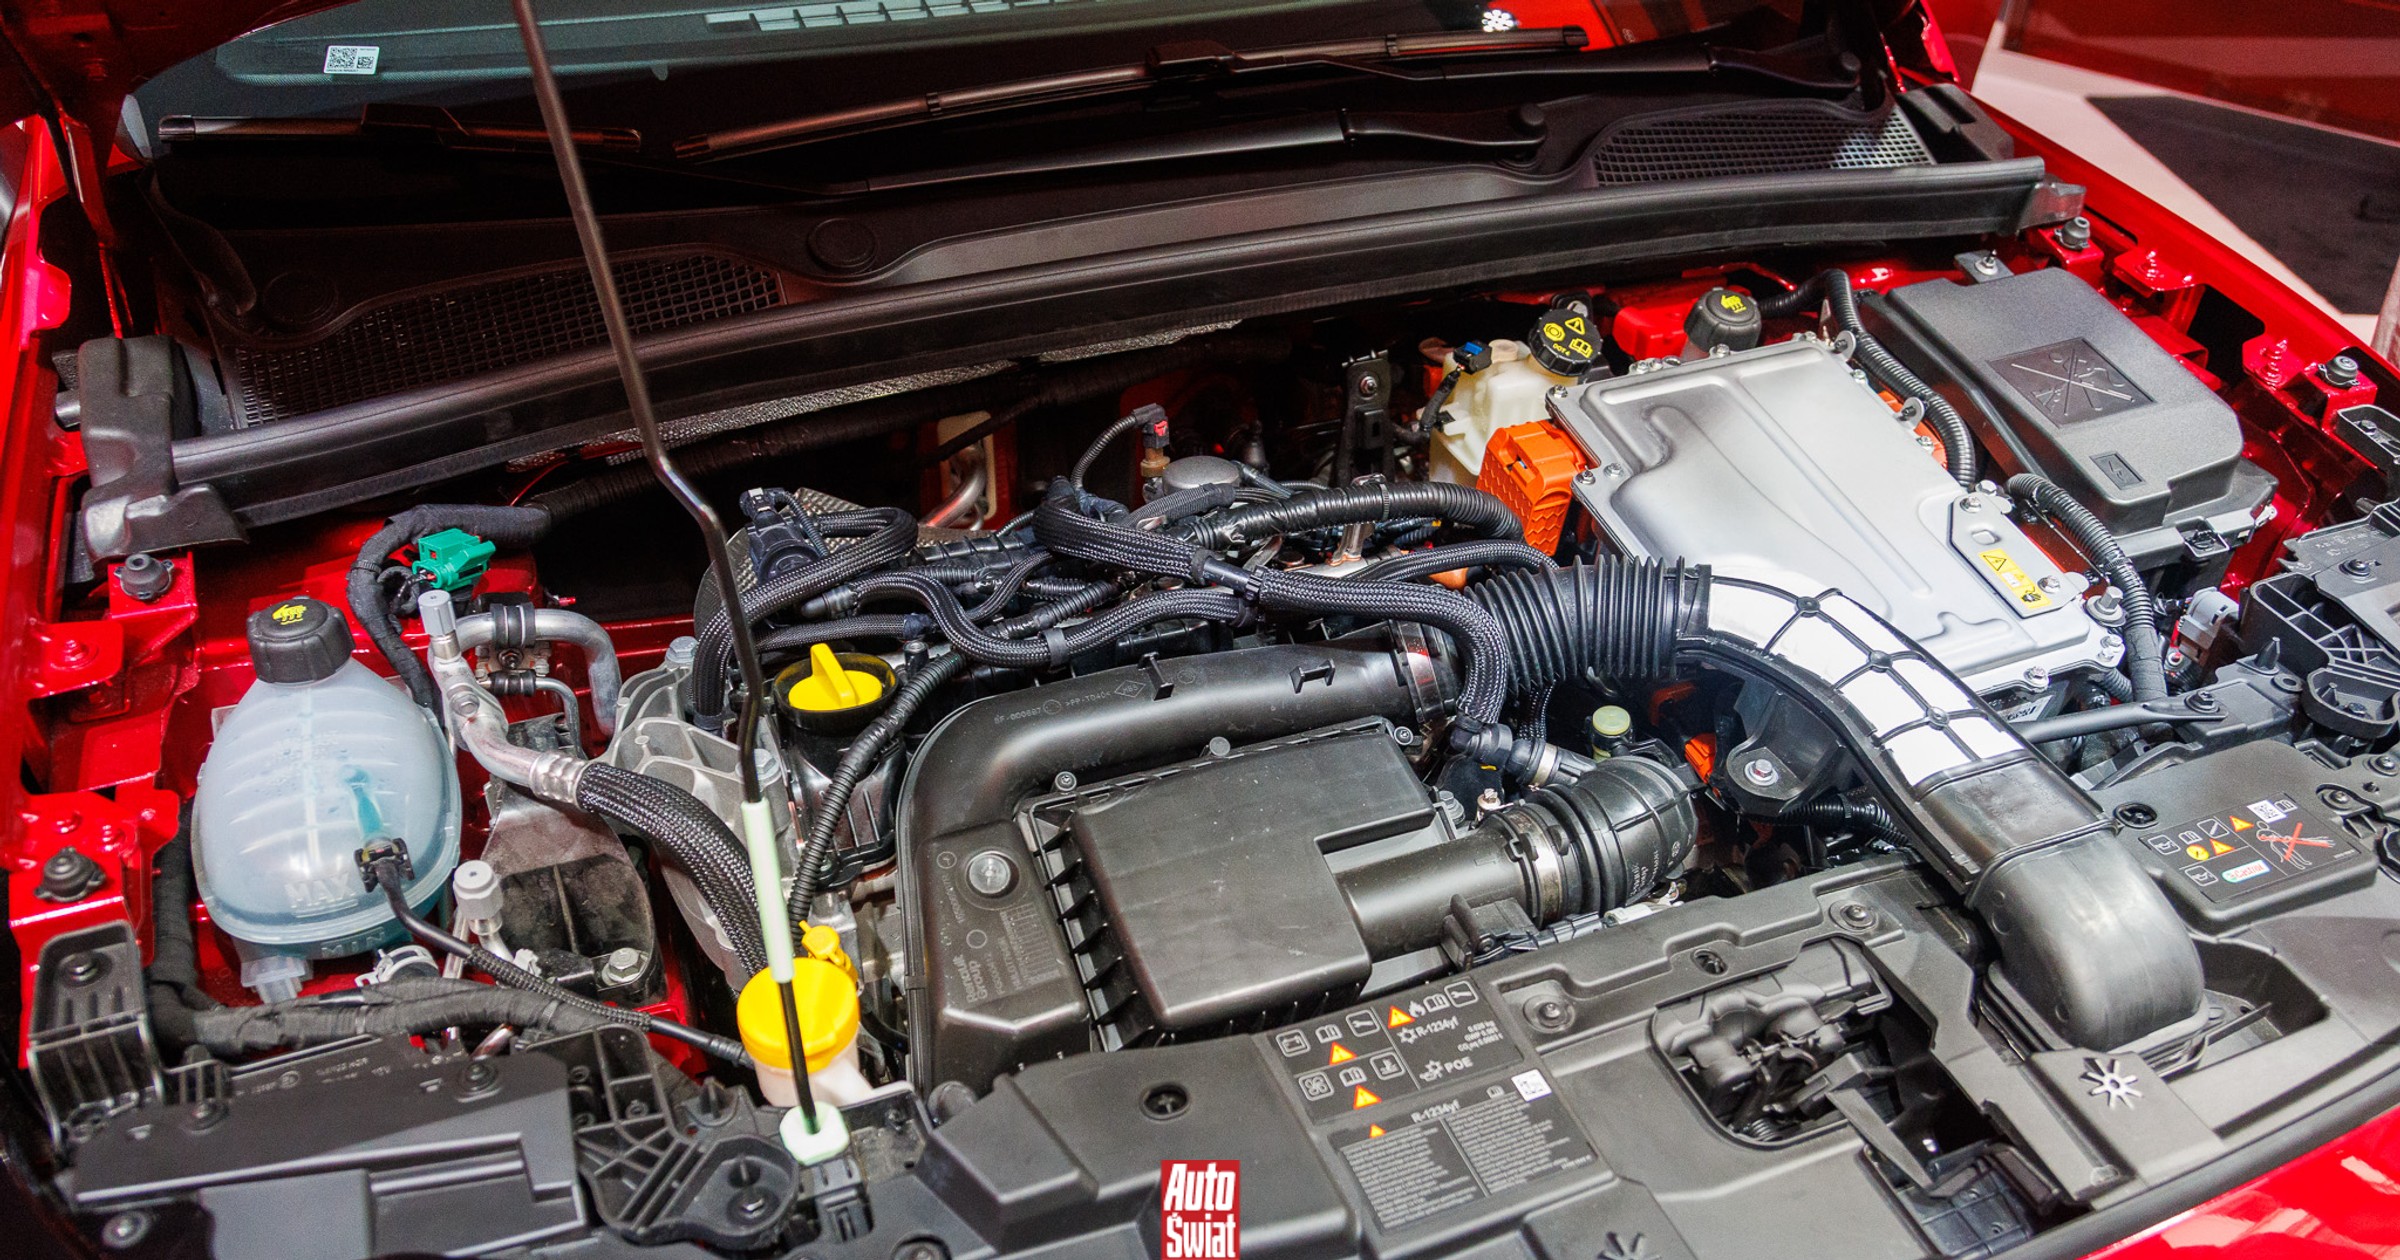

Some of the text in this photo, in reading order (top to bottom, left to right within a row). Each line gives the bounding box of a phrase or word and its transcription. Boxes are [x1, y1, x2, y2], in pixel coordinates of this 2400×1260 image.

[1553, 343, 1567, 354] DOT
[2234, 862, 2266, 878] Castrol
[285, 875, 356, 908] MAX
[321, 931, 385, 958] MIN
[953, 954, 979, 1003] Renault
[968, 960, 988, 1000] Group
[1416, 1016, 1459, 1037] R-1234yf
[1444, 1056, 1474, 1073] POE
[1411, 1099, 1460, 1123] R-1234yf
